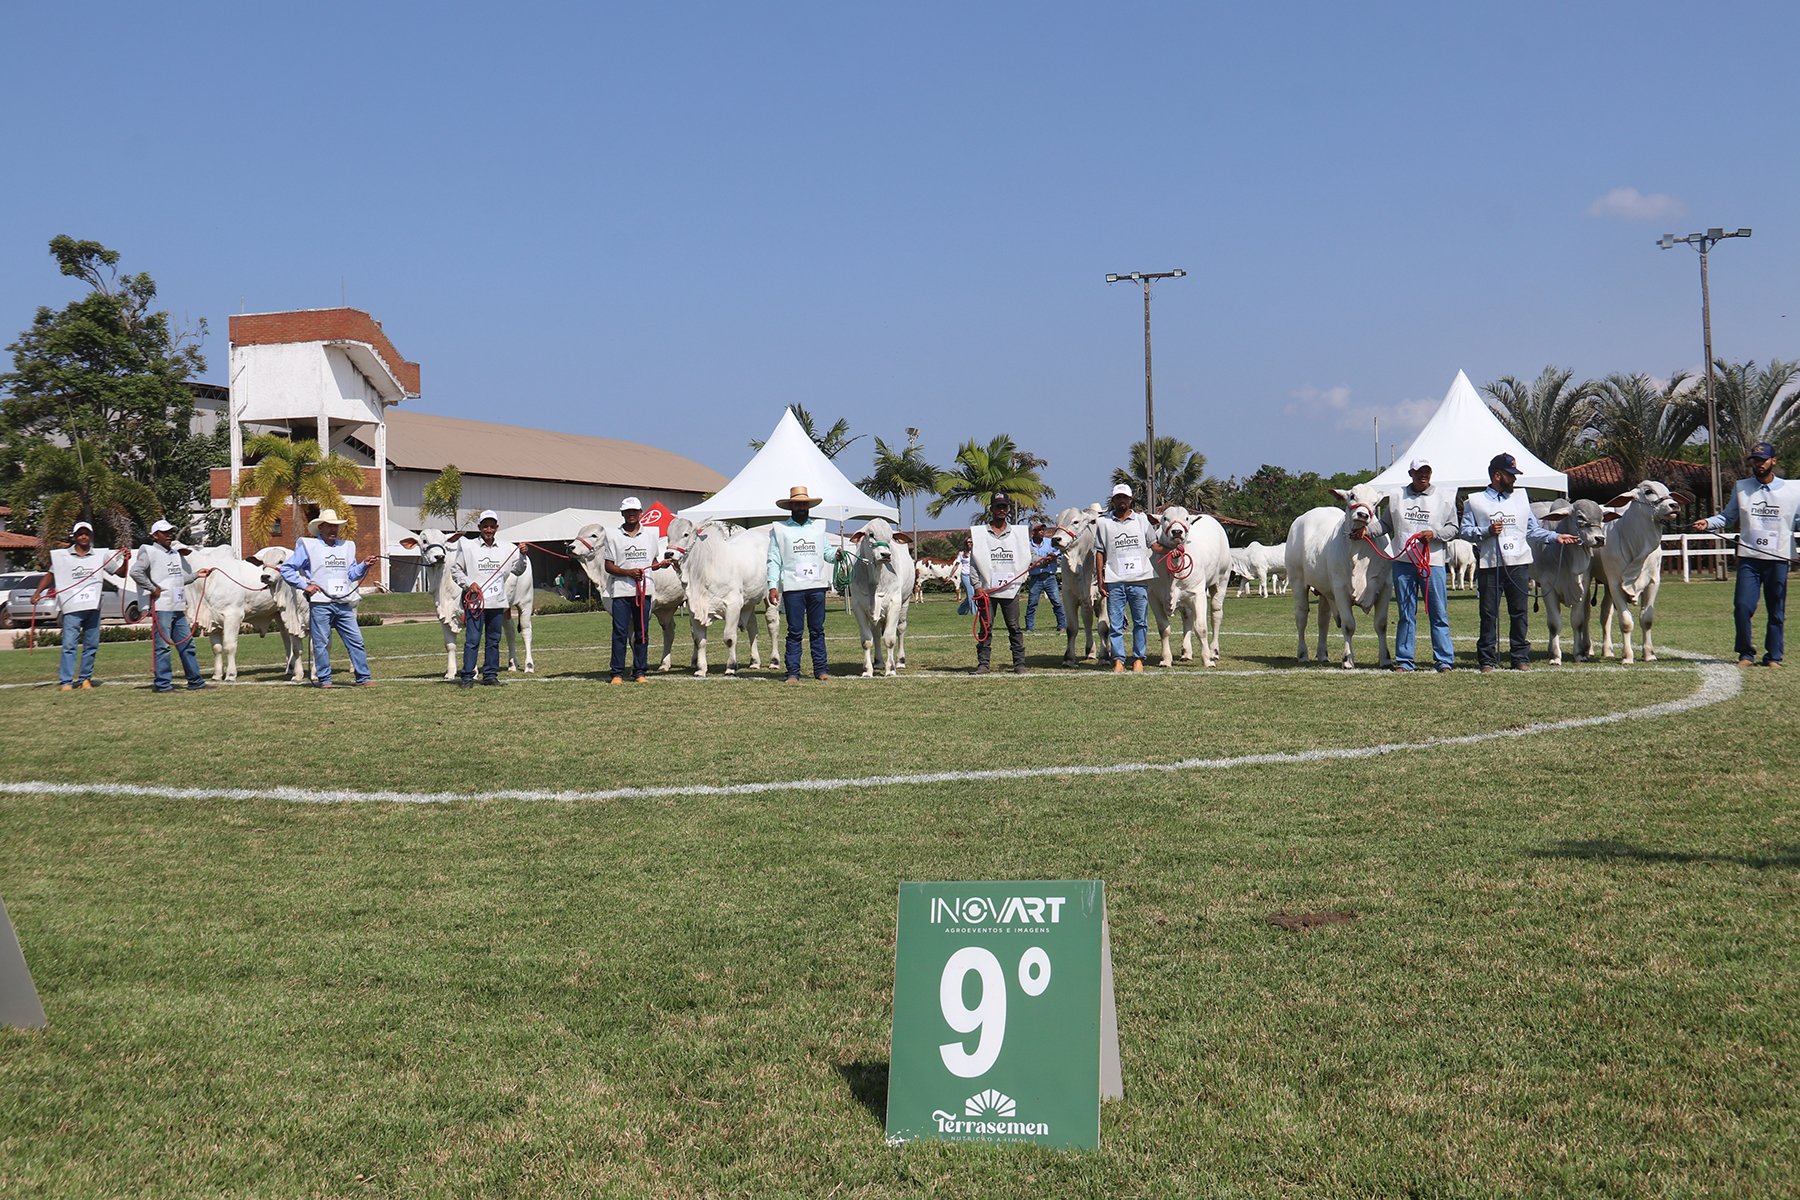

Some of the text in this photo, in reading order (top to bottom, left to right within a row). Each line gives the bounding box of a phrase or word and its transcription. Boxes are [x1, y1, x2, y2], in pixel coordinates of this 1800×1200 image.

[1404, 511, 1430, 519] nelore
[1751, 507, 1780, 515] nelore
[1114, 538, 1139, 546] nelore
[1756, 537, 1769, 546] 68
[1124, 562, 1135, 570] 72
[489, 586, 499, 594] 76
[930, 896, 1066, 924] INOVART
[931, 1109, 1049, 1136] Terrasemen
